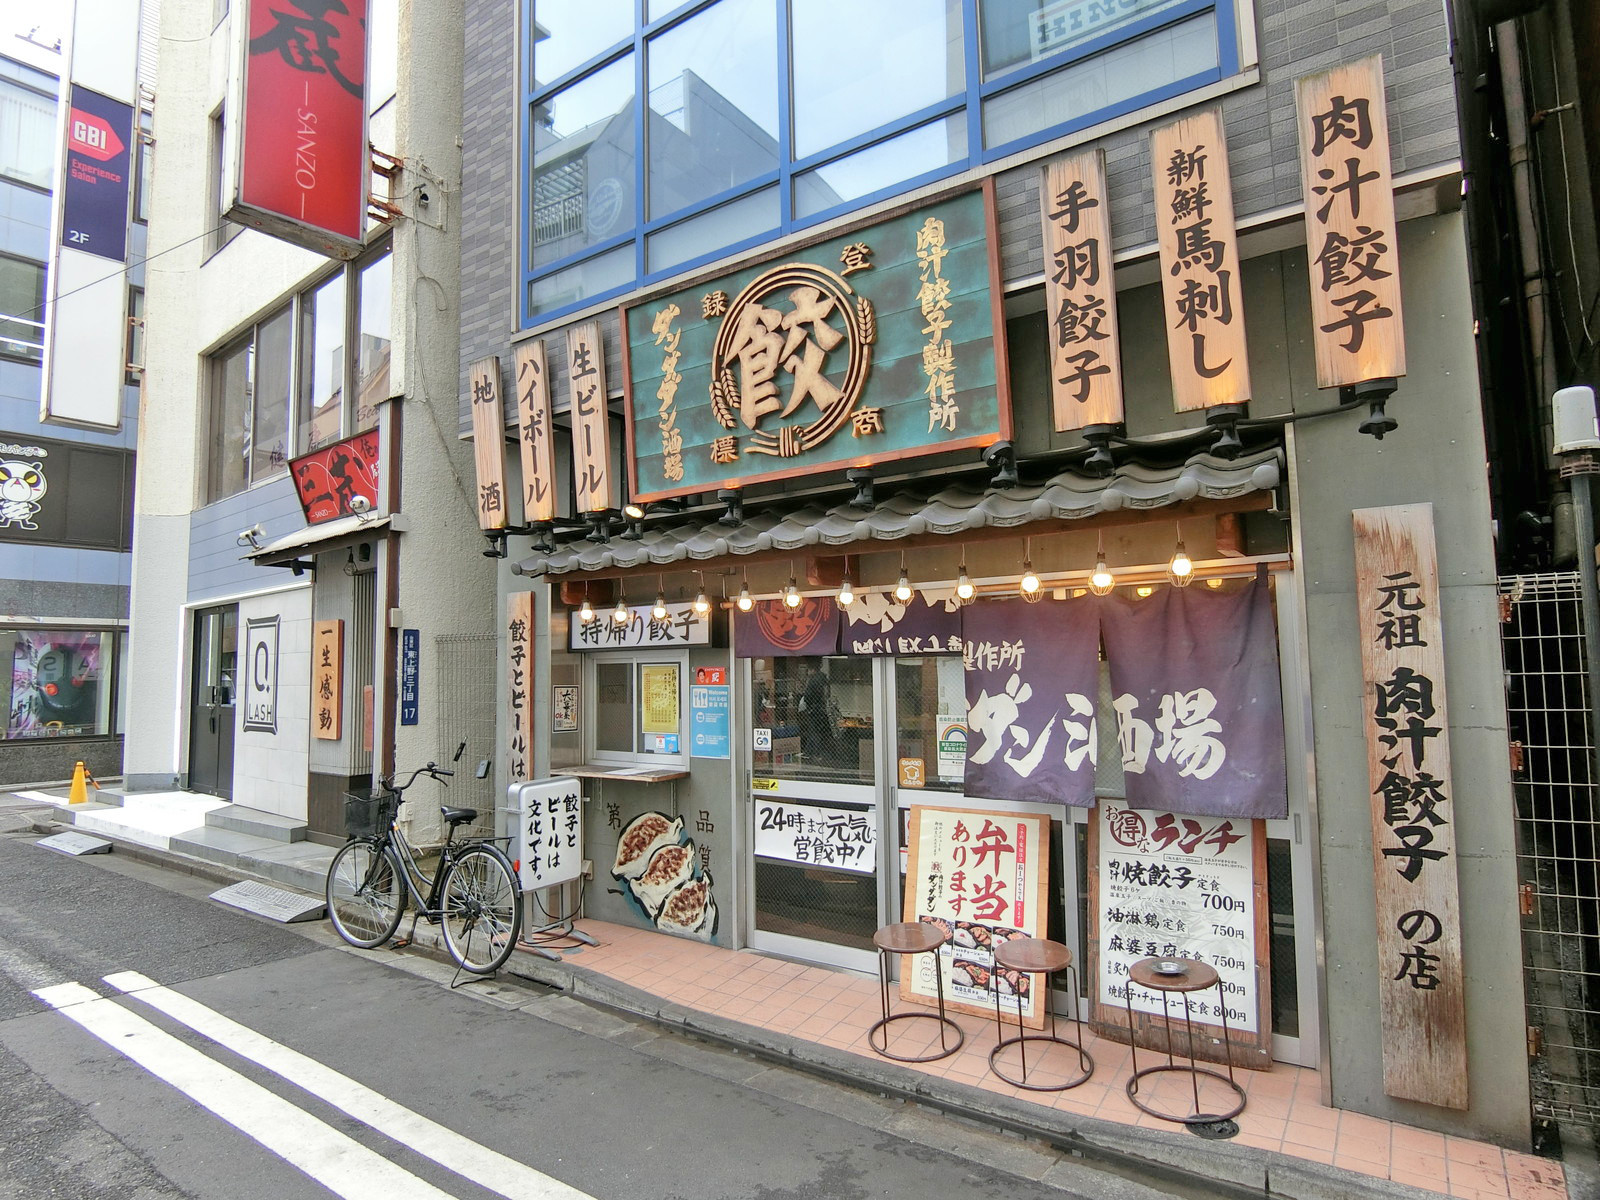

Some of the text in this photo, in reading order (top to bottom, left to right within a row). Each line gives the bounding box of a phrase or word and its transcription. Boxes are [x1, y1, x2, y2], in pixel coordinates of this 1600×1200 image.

[72, 159, 121, 182] Experience
[74, 121, 107, 150] GBI
[296, 108, 318, 189] SANZO
[71, 169, 97, 184] Salon
[69, 230, 89, 244] 2F
[1166, 145, 1233, 379] 新鮮馬刺し
[1311, 95, 1393, 353] 肉汁餃子
[915, 216, 961, 433] 肉汁餃子製作所
[1048, 181, 1111, 403] 手羽餃子
[701, 242, 884, 464] 登 録 商 標
[722, 285, 844, 430] 餃
[571, 341, 605, 498] 生ビール
[652, 303, 685, 482] ダンダダン酒場
[474, 368, 501, 512] 地酒
[516, 358, 549, 506] ハイボール
[580, 609, 699, 645] 持帰り餃子
[248, 704, 273, 721] LASH
[319, 629, 333, 731] 一生感動
[404, 708, 415, 719] 17
[407, 650, 415, 701] 東上野三丁目
[509, 619, 528, 783] 餃子とビールは
[756, 737, 769, 746] GO
[528, 800, 543, 880] 文化です。
[548, 796, 561, 868] ビールは
[563, 794, 580, 847] 餃子と
[1105, 805, 1247, 857] お得な ランチ
[948, 820, 971, 917] あります
[970, 819, 1015, 921] 弁当
[1201, 893, 1245, 913] 700円
[1212, 924, 1245, 939] 750円
[1212, 955, 1245, 971] 750円
[1213, 1005, 1247, 1022] 800円
